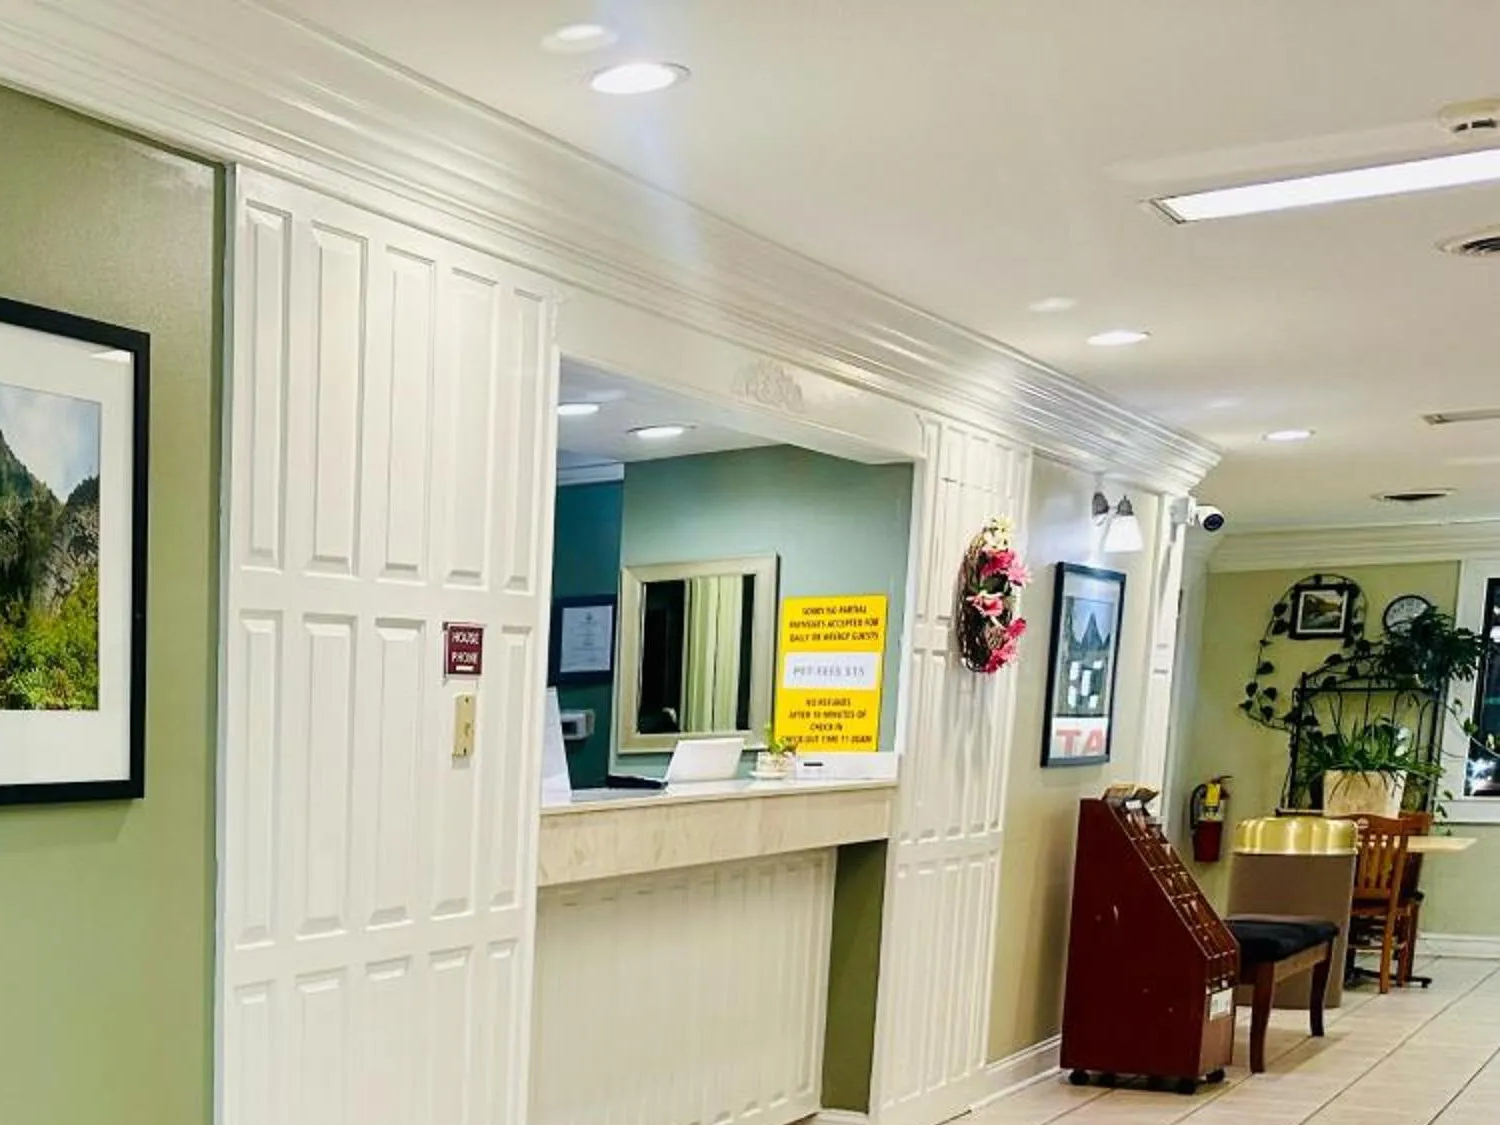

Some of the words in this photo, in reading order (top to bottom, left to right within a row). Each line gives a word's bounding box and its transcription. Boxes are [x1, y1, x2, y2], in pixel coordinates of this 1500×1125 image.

[827, 618, 862, 628] ACCEPTED
[864, 617, 879, 627] FOR
[451, 631, 479, 645] HOUSE
[789, 633, 810, 642] DAILY
[811, 633, 821, 641] OR
[823, 632, 850, 641] WEEKLY
[851, 631, 879, 641] GUESTS
[451, 651, 478, 664] PHONE
[788, 709, 811, 719] AFTER
[823, 709, 855, 718] MINUTES
